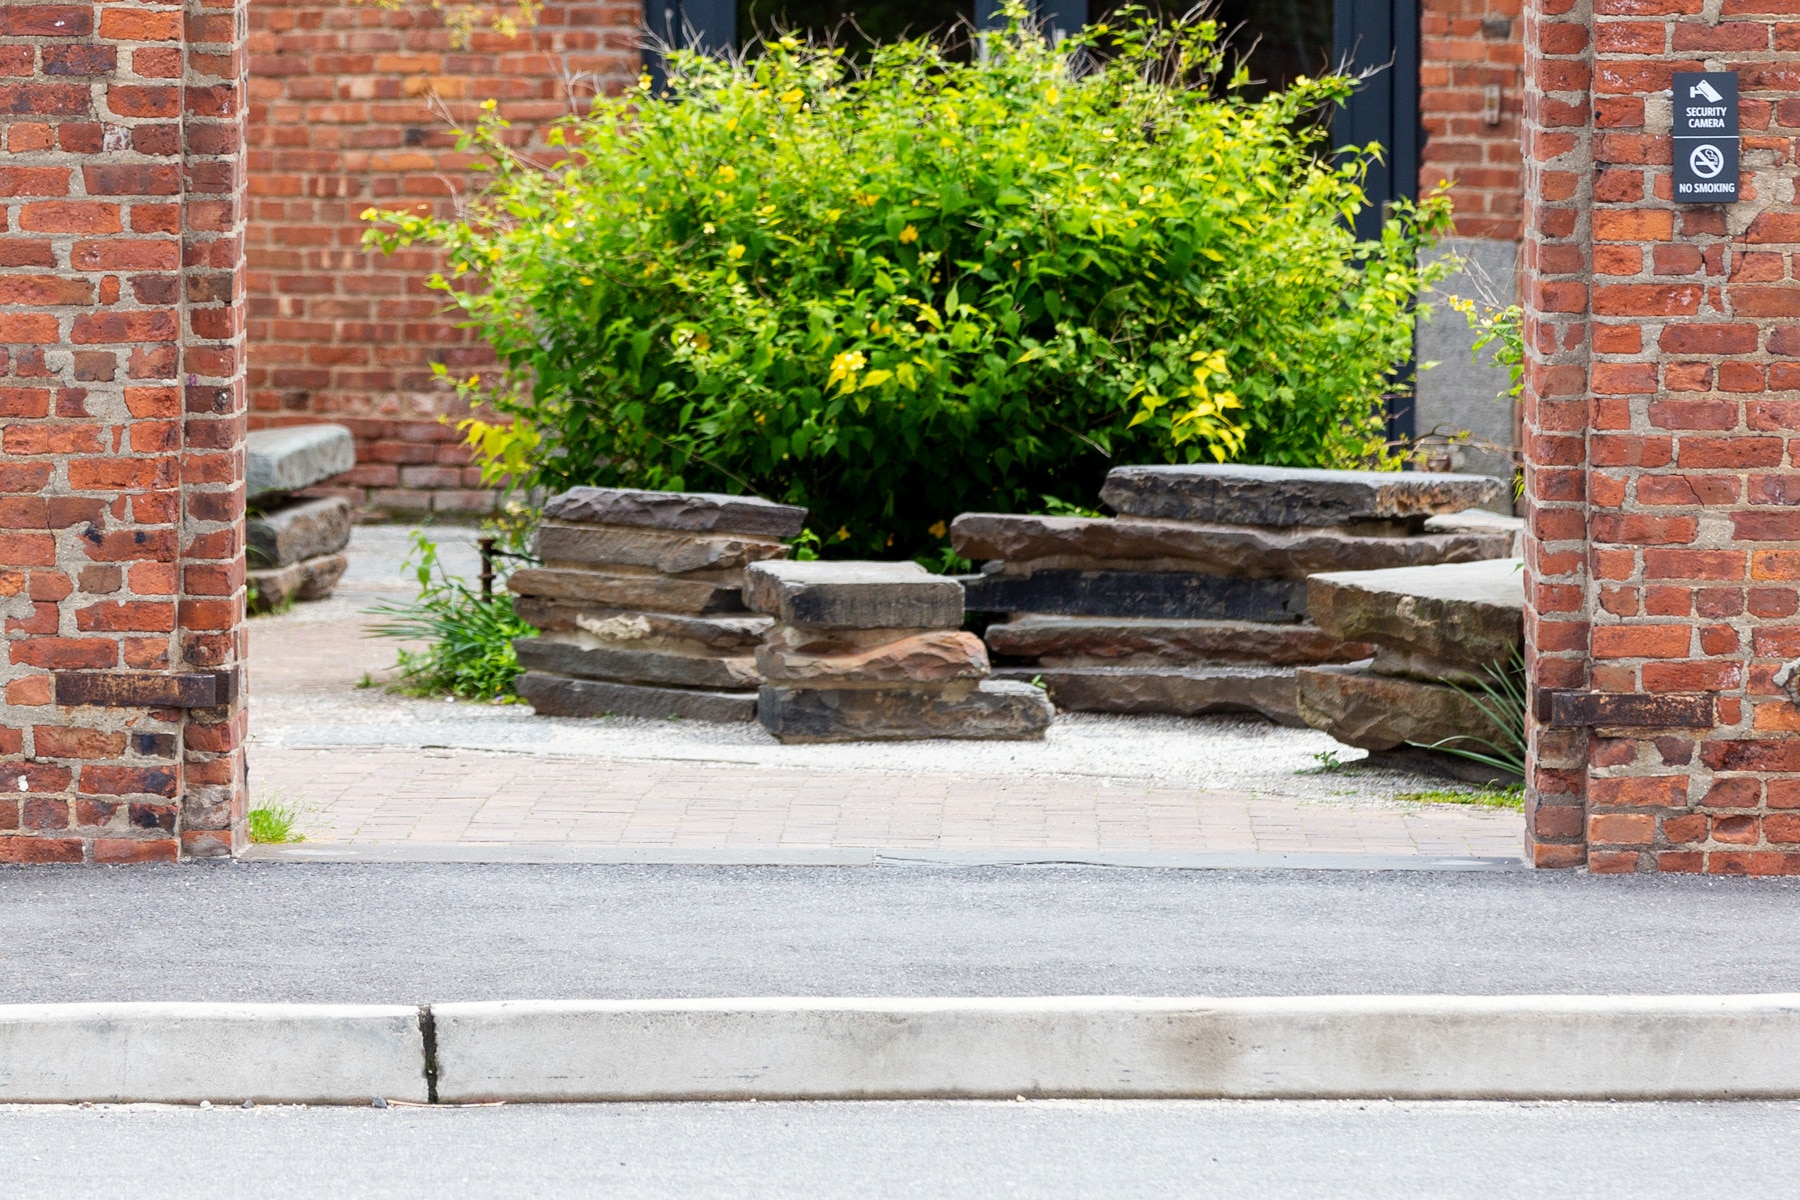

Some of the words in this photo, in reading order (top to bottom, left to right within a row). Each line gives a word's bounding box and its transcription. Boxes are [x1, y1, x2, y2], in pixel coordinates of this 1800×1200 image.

[1686, 107, 1727, 117] SECURITY
[1688, 118, 1725, 128] CAMERA
[1679, 183, 1692, 193] NO
[1694, 183, 1735, 193] SMOKING
